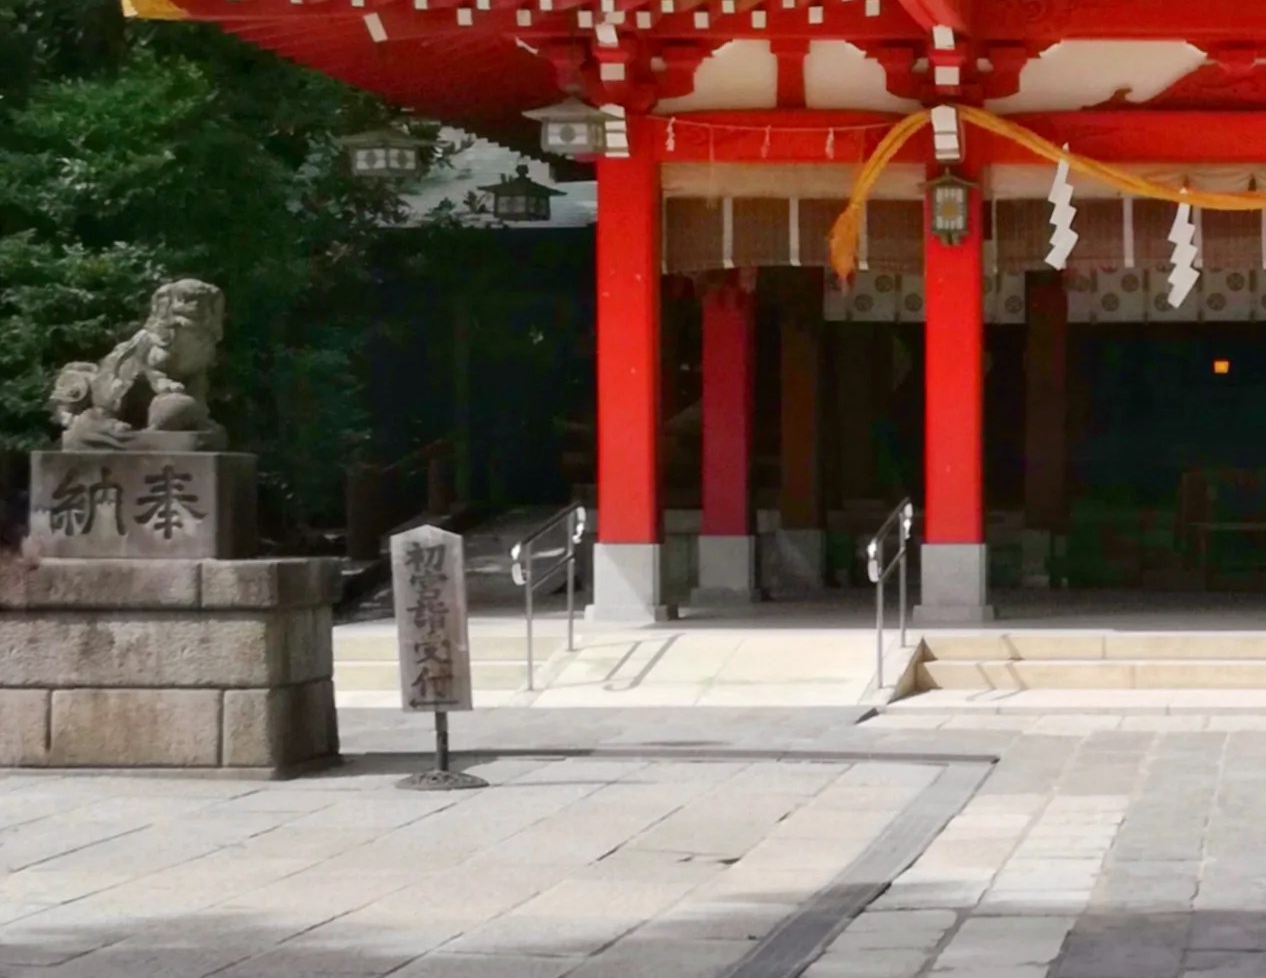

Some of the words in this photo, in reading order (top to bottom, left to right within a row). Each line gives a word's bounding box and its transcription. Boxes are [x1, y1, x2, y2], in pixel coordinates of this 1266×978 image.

[404, 541, 454, 698] 初宮詣受付
